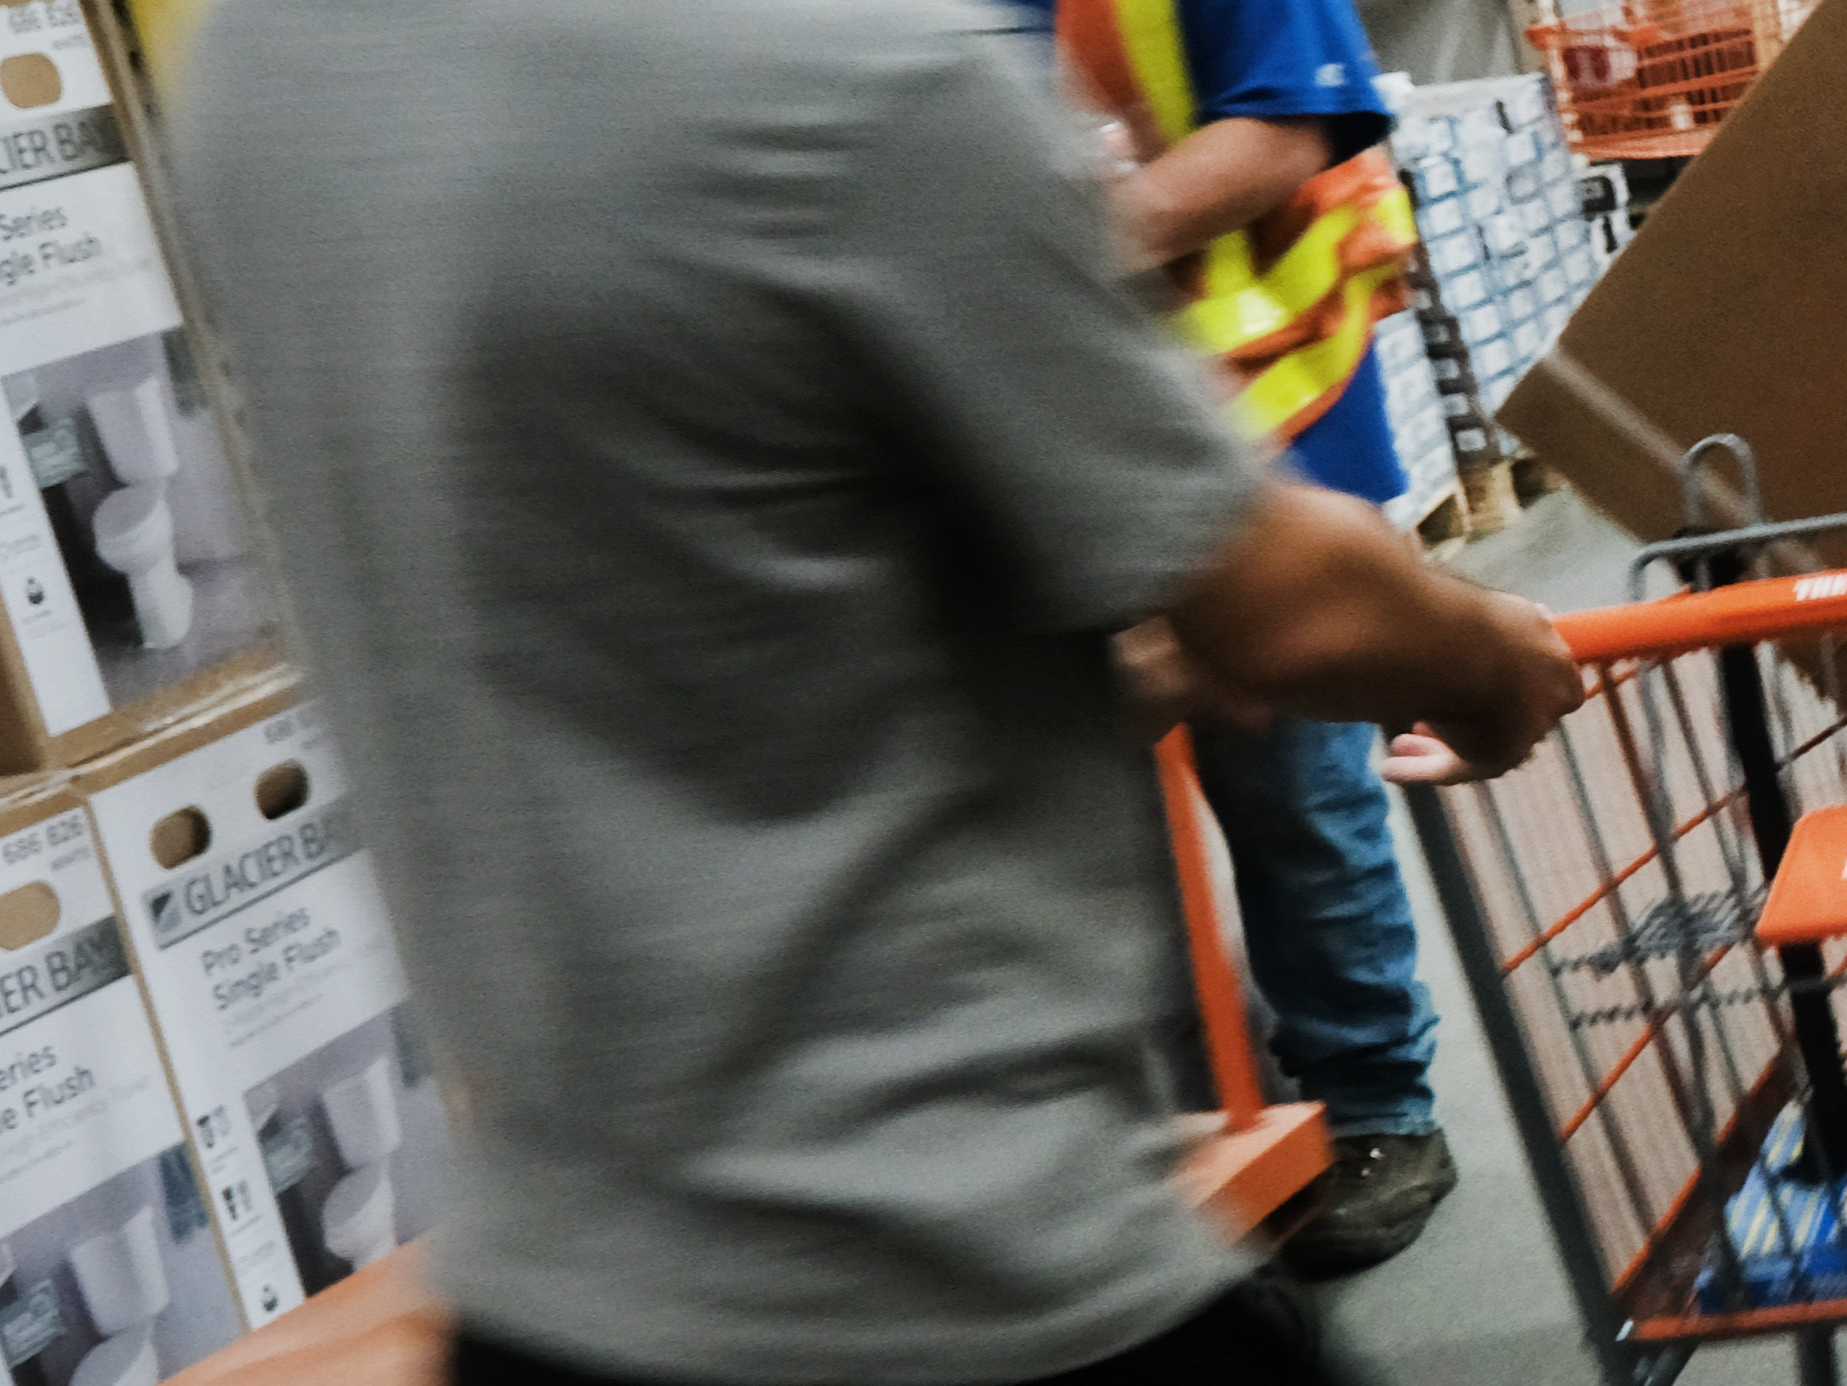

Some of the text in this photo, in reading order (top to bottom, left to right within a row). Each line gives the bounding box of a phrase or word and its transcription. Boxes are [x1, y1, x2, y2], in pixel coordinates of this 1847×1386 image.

[183, 832, 296, 918] GLACIER
[201, 903, 312, 978] Pro Series
[212, 926, 343, 1011] Single Flush
[0, 1043, 58, 1092] eries
[26, 1065, 95, 1121] Flush
